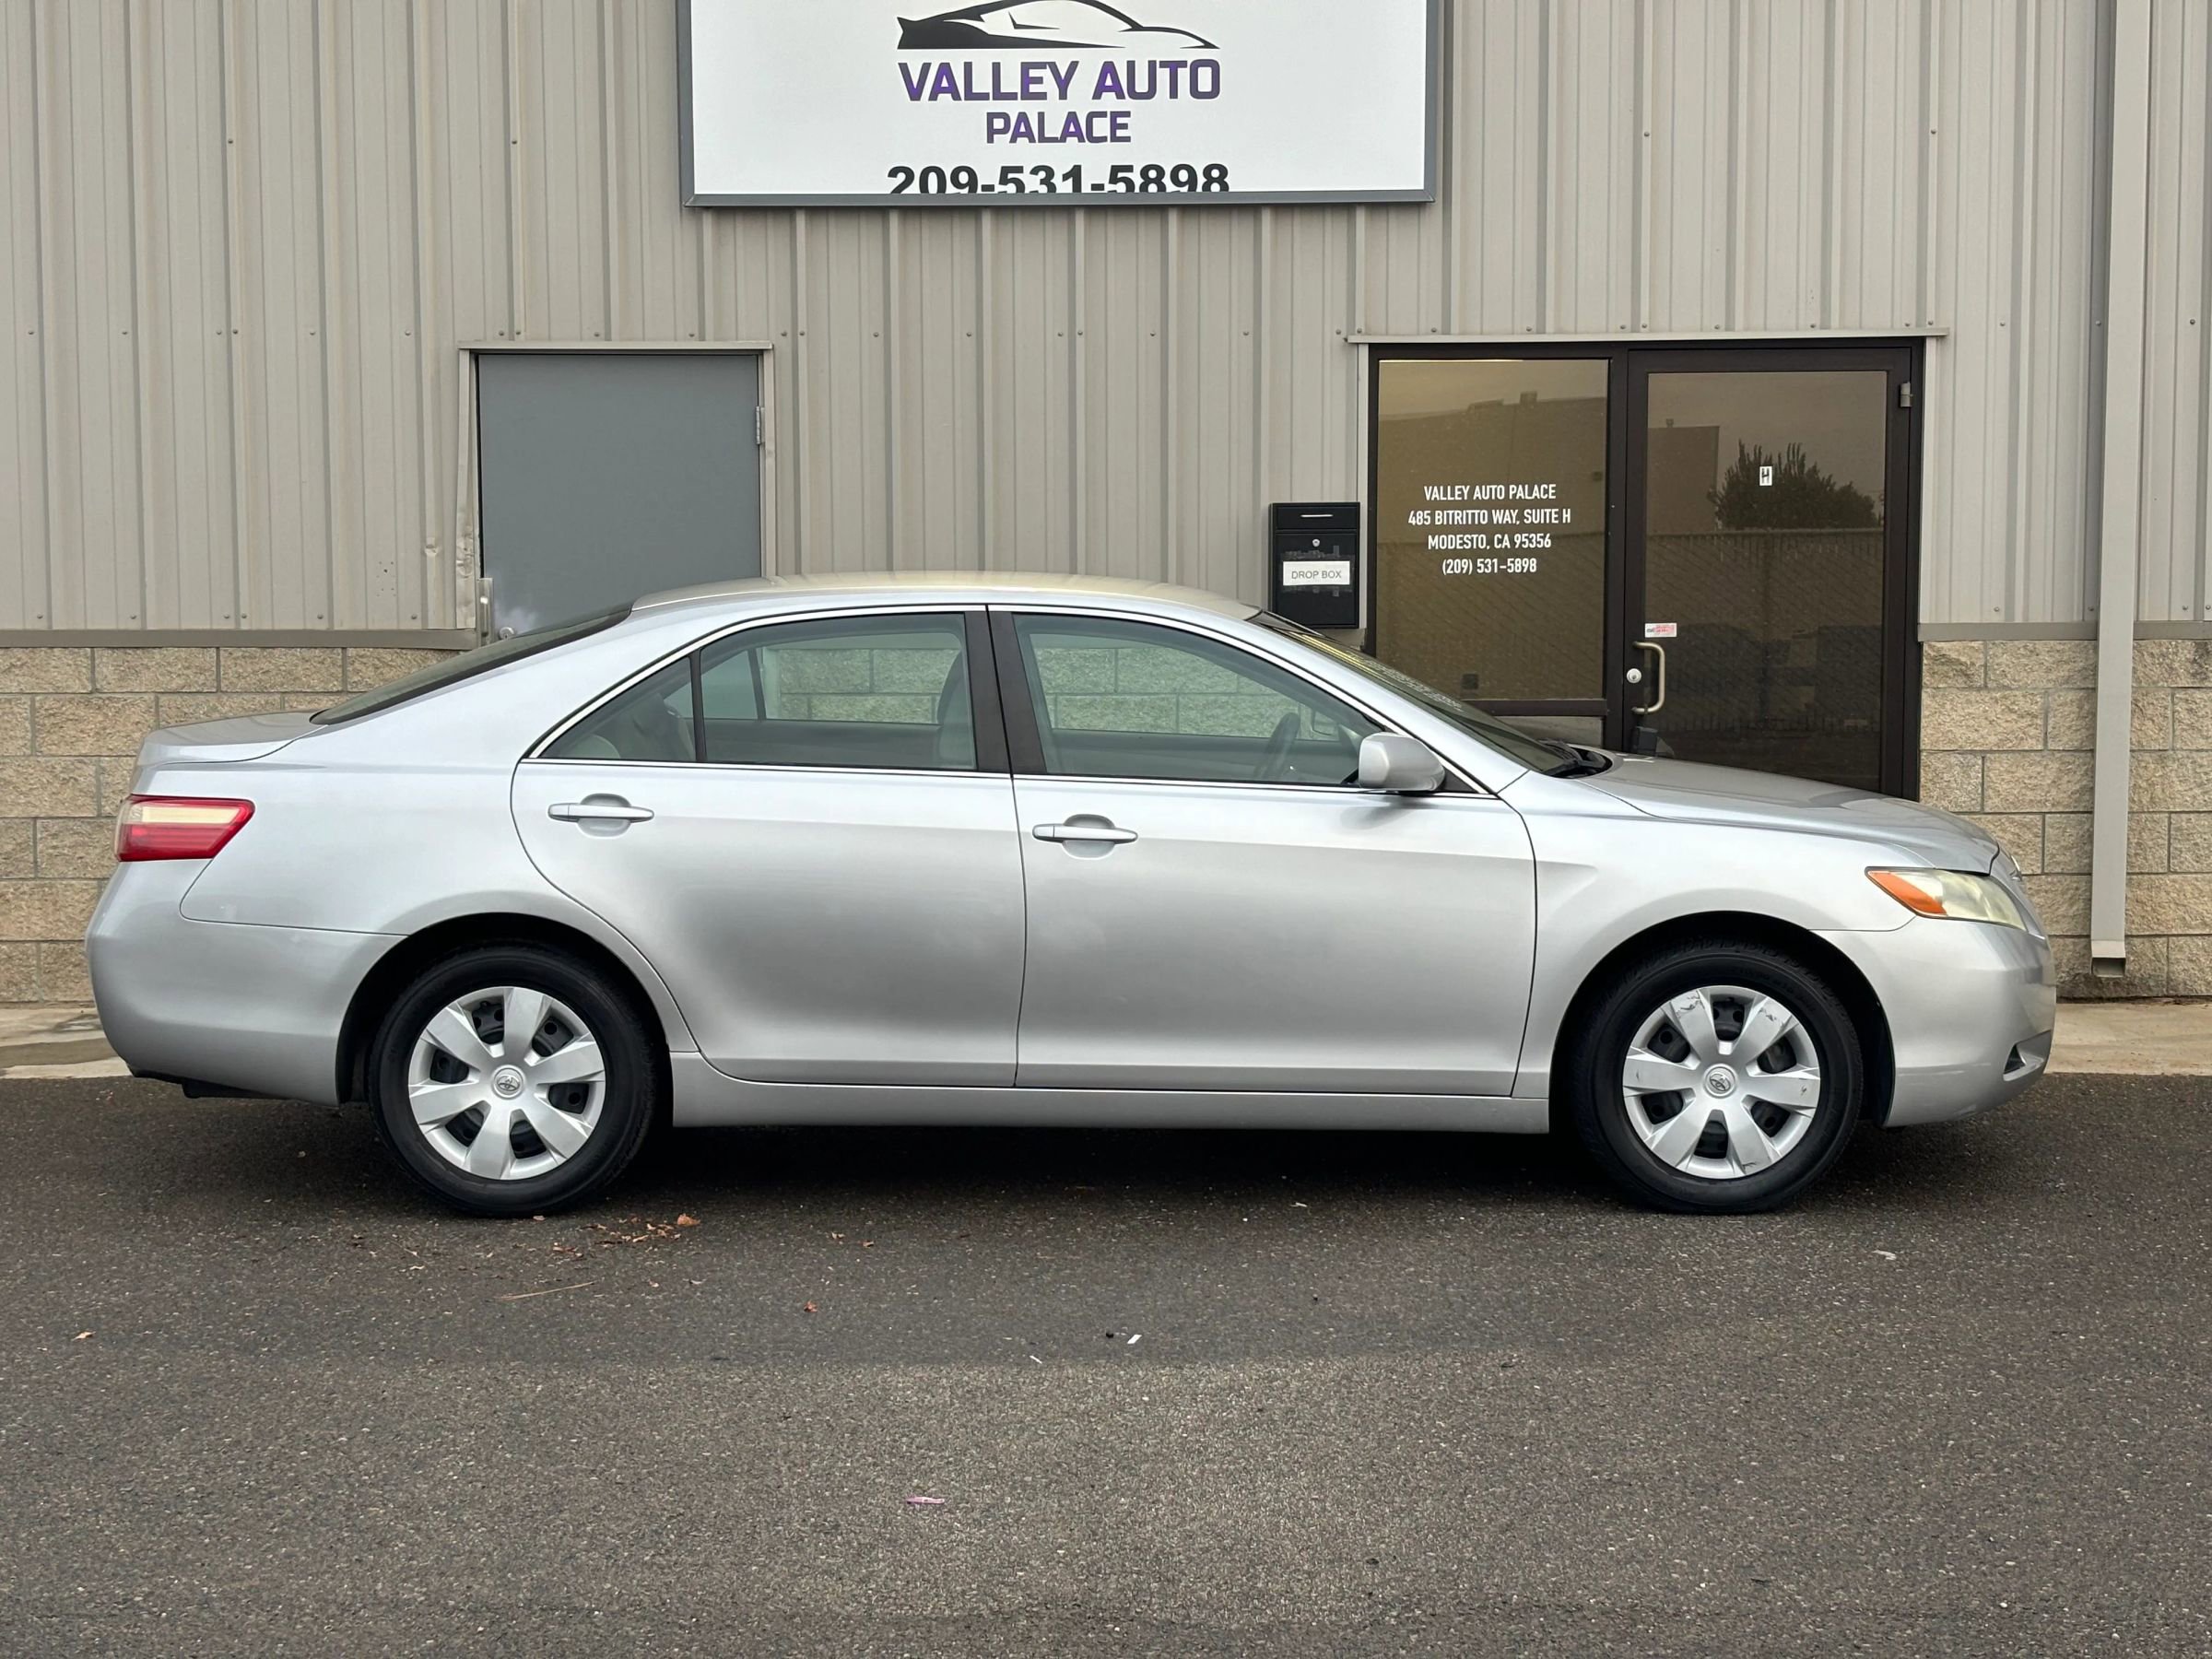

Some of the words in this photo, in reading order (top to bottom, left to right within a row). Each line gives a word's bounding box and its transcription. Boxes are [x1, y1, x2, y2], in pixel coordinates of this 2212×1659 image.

[898, 60, 1079, 101] VALLEY
[1091, 59, 1220, 100] AUTO
[986, 111, 1131, 144] PALACE
[887, 163, 1230, 194] 209-531-5898
[1762, 468, 1770, 484] H
[1424, 486, 1470, 500] VALLEY
[1474, 485, 1505, 500] AUTO
[1510, 484, 1557, 500] PALACE
[1408, 511, 1430, 524] 485
[1435, 510, 1488, 524] BITRITTO
[1492, 510, 1520, 524] WAY,
[1524, 509, 1559, 524] SUITE
[1562, 509, 1571, 523] H
[1428, 535, 1490, 549] MODESTO,
[1494, 534, 1510, 548] CA
[1514, 534, 1551, 548] 95356
[1442, 559, 1473, 575] (209)
[1477, 558, 1537, 573] 531-5898
[1291, 571, 1319, 580] DROP
[1321, 570, 1342, 579] BOX
